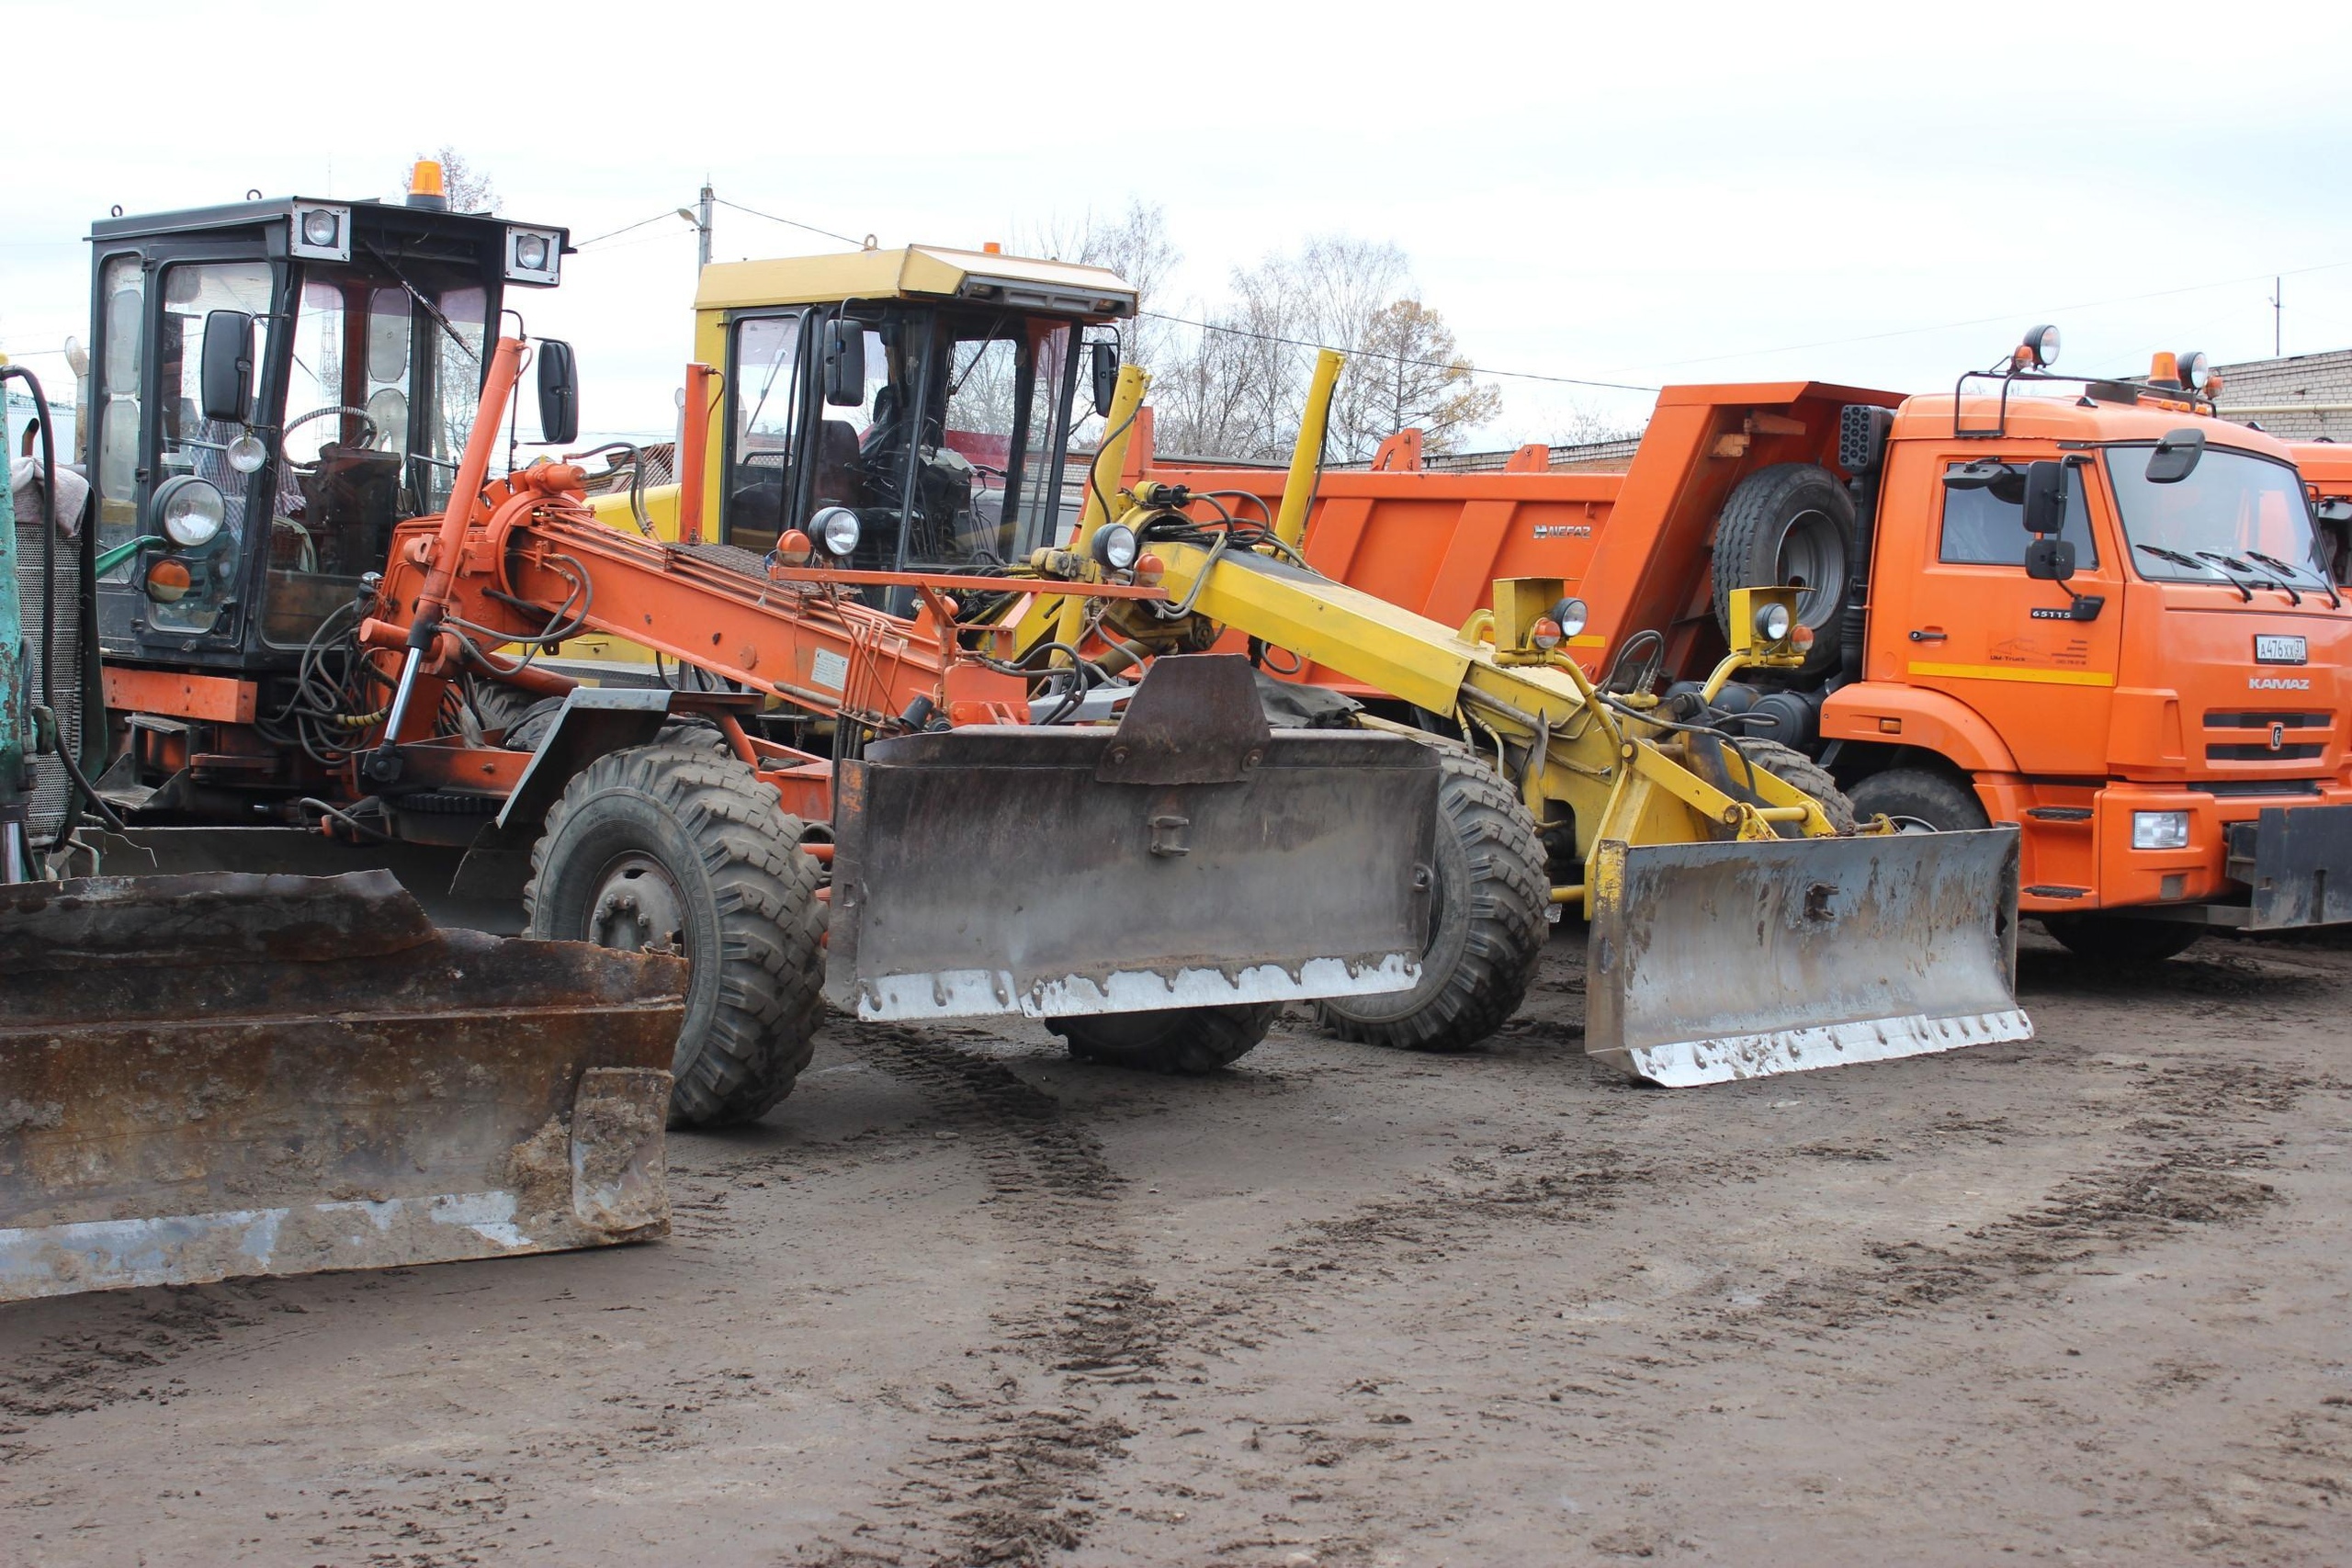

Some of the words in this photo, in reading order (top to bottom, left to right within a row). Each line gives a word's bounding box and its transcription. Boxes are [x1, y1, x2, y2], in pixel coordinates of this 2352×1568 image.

[1549, 525, 1591, 538] NEFAZ
[2032, 611, 2071, 619] 65115
[2248, 679, 2310, 689] KAMAZ
